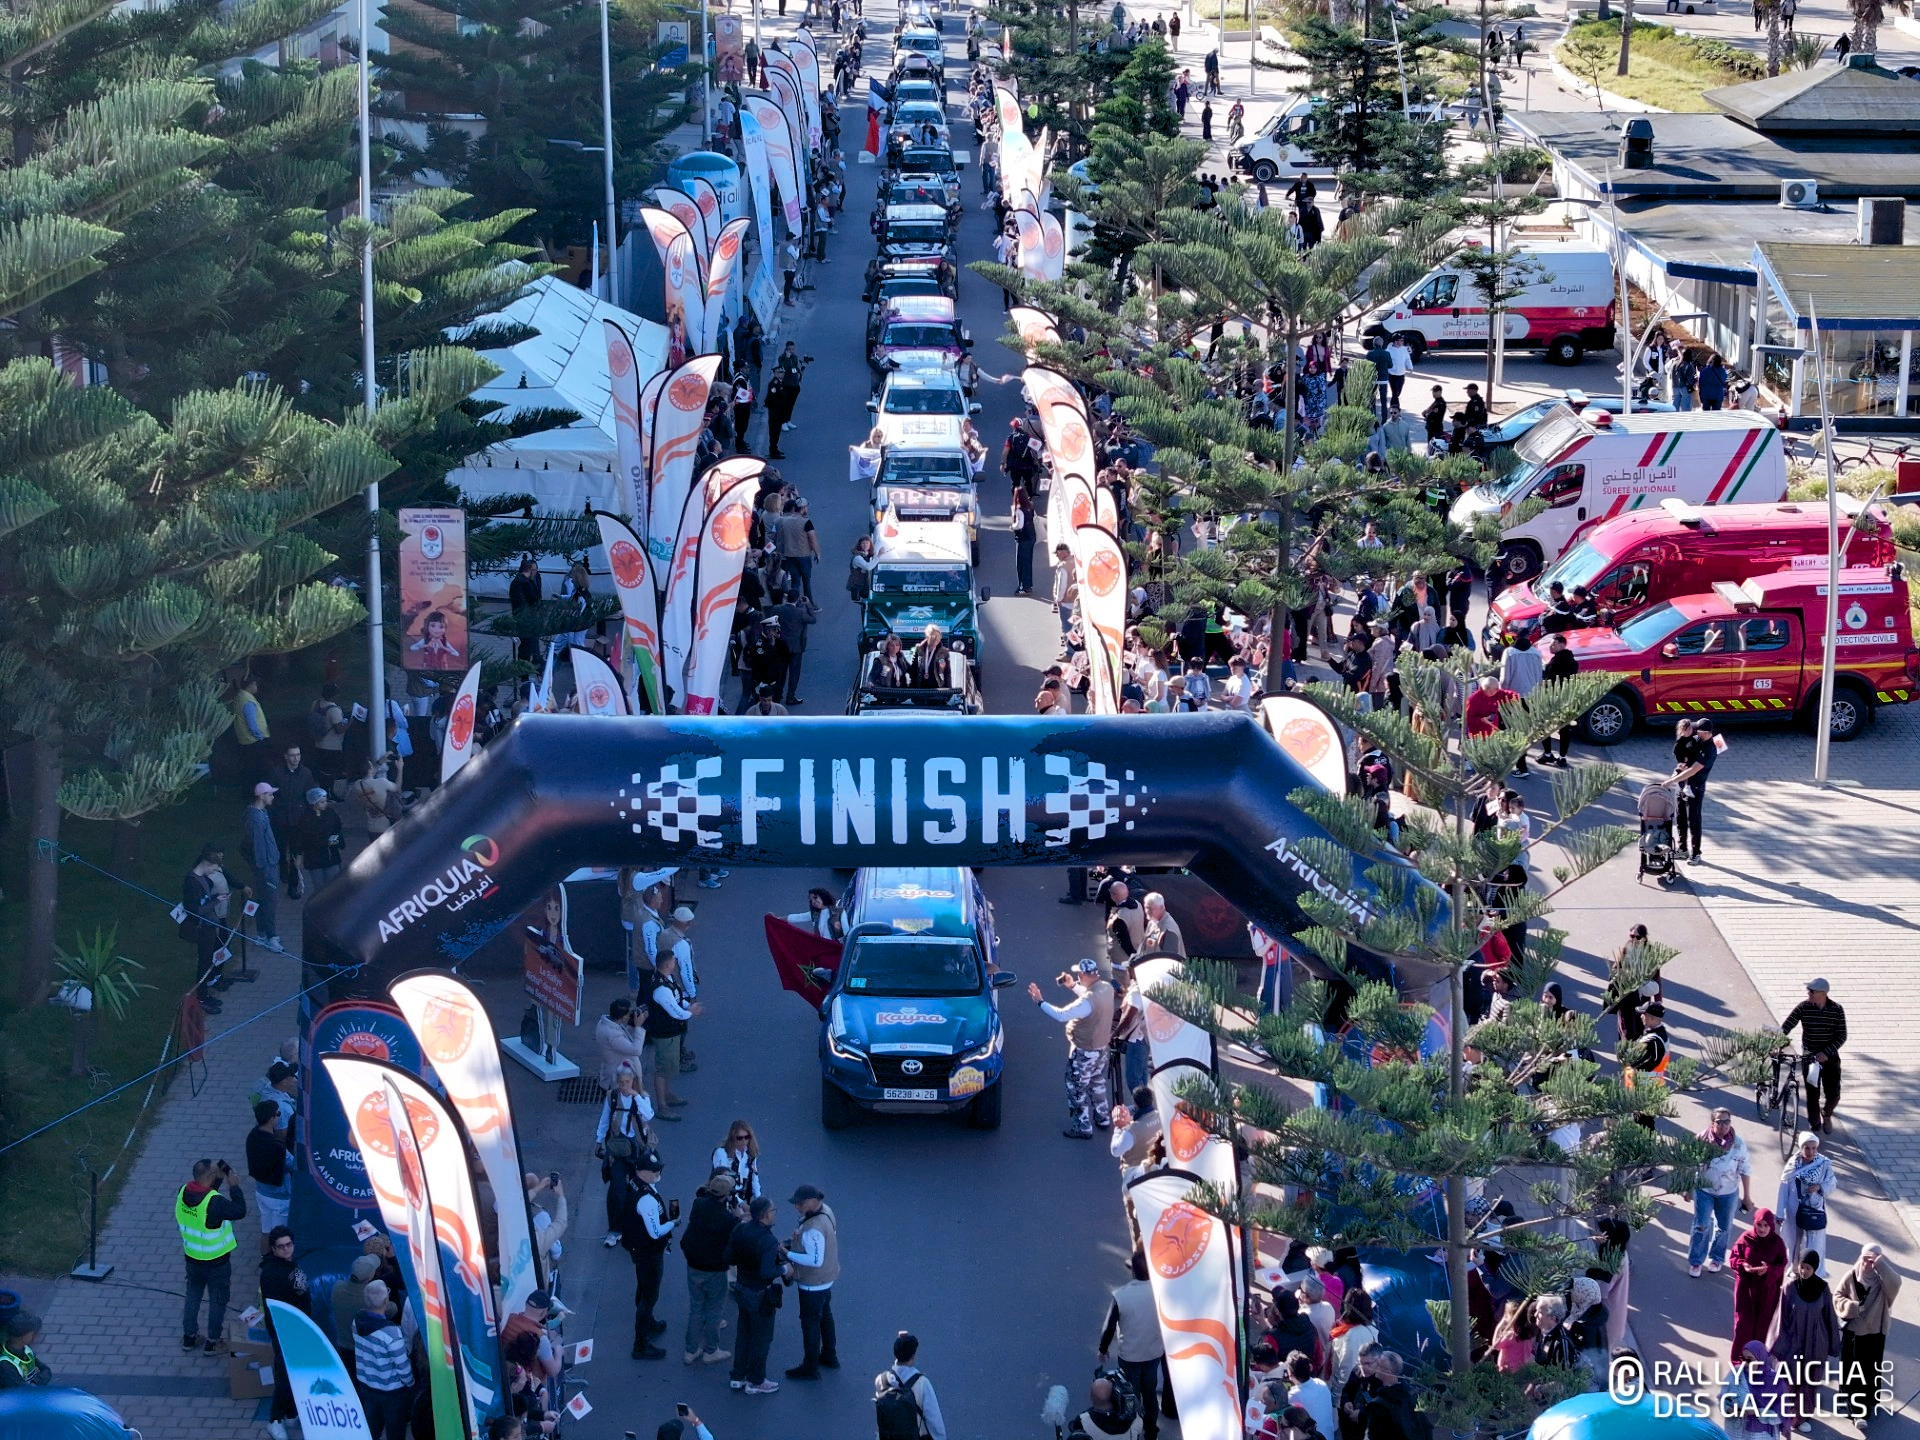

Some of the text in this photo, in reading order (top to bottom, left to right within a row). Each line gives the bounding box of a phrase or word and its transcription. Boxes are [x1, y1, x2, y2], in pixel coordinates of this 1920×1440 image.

[1649, 465, 1677, 483] الأمن
[1602, 485, 1677, 495] SÛRETÉ NATIONALE
[1836, 635, 1895, 645] OTECTION CIVILE
[741, 756, 1026, 845] FINISH
[378, 858, 484, 943] AFRIQUIA
[876, 1012, 947, 1025] Kayna
[347, 1034, 381, 1048] RALLYE
[886, 1088, 912, 1098] 56238
[924, 1090, 935, 1098] 26
[318, 1164, 335, 1185] ANS
[336, 1182, 349, 1194] DE
